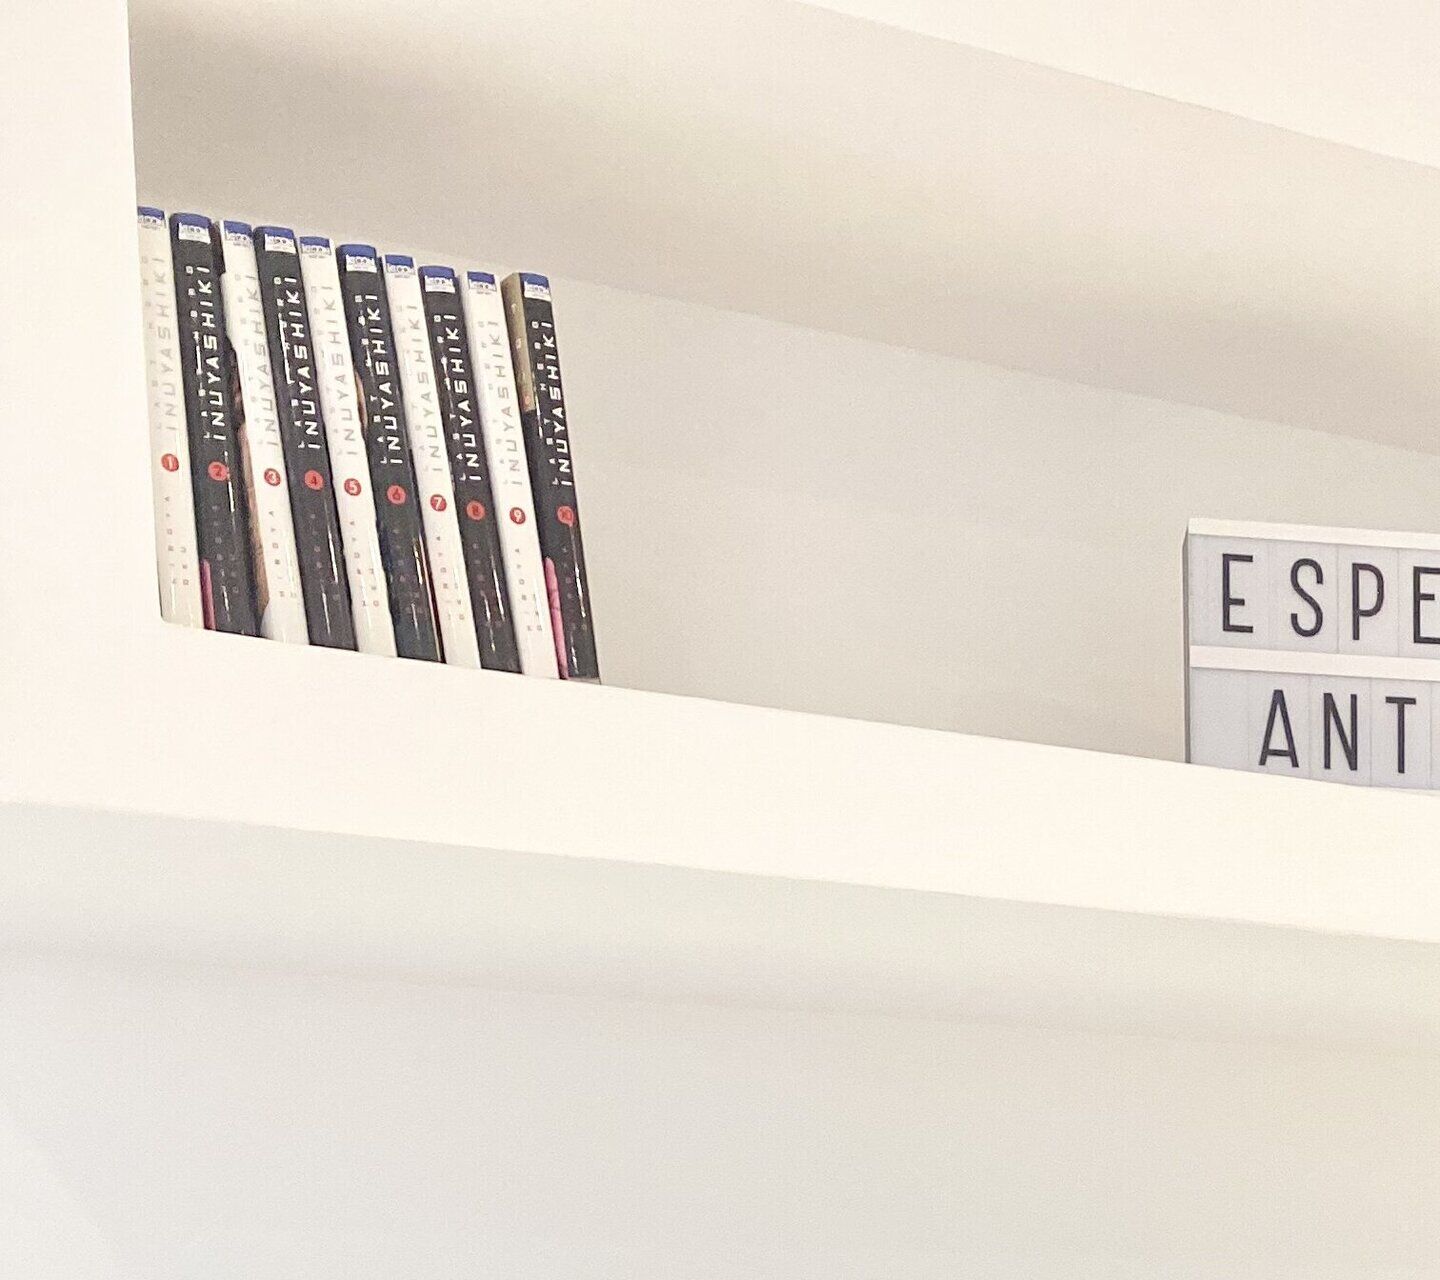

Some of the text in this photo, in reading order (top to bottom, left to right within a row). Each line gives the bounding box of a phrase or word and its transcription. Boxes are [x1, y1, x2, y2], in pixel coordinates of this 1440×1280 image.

[151, 257, 177, 431] INUYASHIKI
[196, 266, 227, 440] INUYASHIKI
[243, 274, 279, 446] INUYASHIKI
[284, 277, 321, 449] INUYASHIKI
[321, 286, 358, 455] INUYASHIKI
[364, 294, 403, 464] INUYASHIKI
[407, 304, 443, 471] INUYASHIKI
[443, 315, 482, 480] INUYASHIKI
[487, 321, 522, 486] INUYASHIKI
[541, 322, 573, 486] INUYASHIKI
